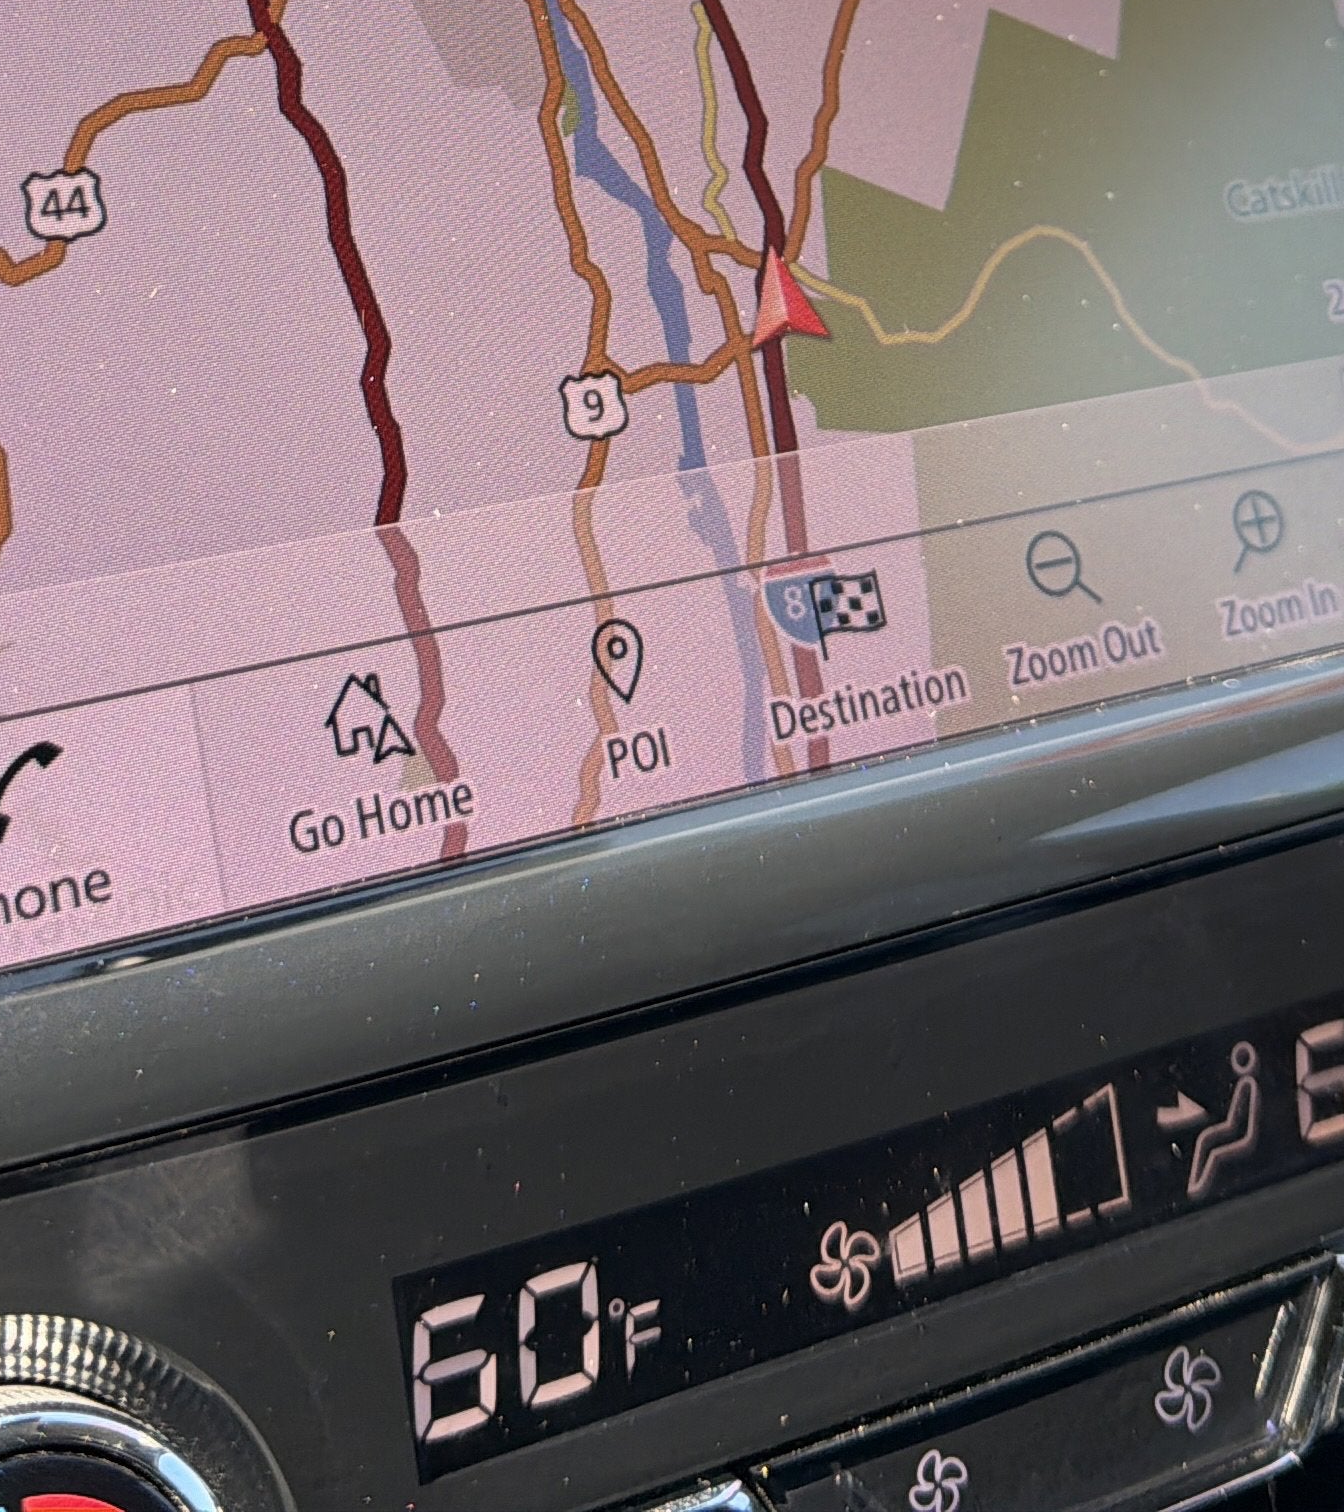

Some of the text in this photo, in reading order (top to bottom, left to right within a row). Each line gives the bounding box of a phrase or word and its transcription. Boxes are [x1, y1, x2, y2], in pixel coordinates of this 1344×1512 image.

[41, 186, 90, 221] 44
[1226, 166, 1339, 218] Catskill
[583, 389, 604, 422] 9
[1222, 596, 1304, 637] Zoom
[1007, 620, 1161, 686] Zoom Out
[770, 666, 967, 742] Destination
[607, 727, 670, 780] POI
[288, 781, 475, 854] Go Home
